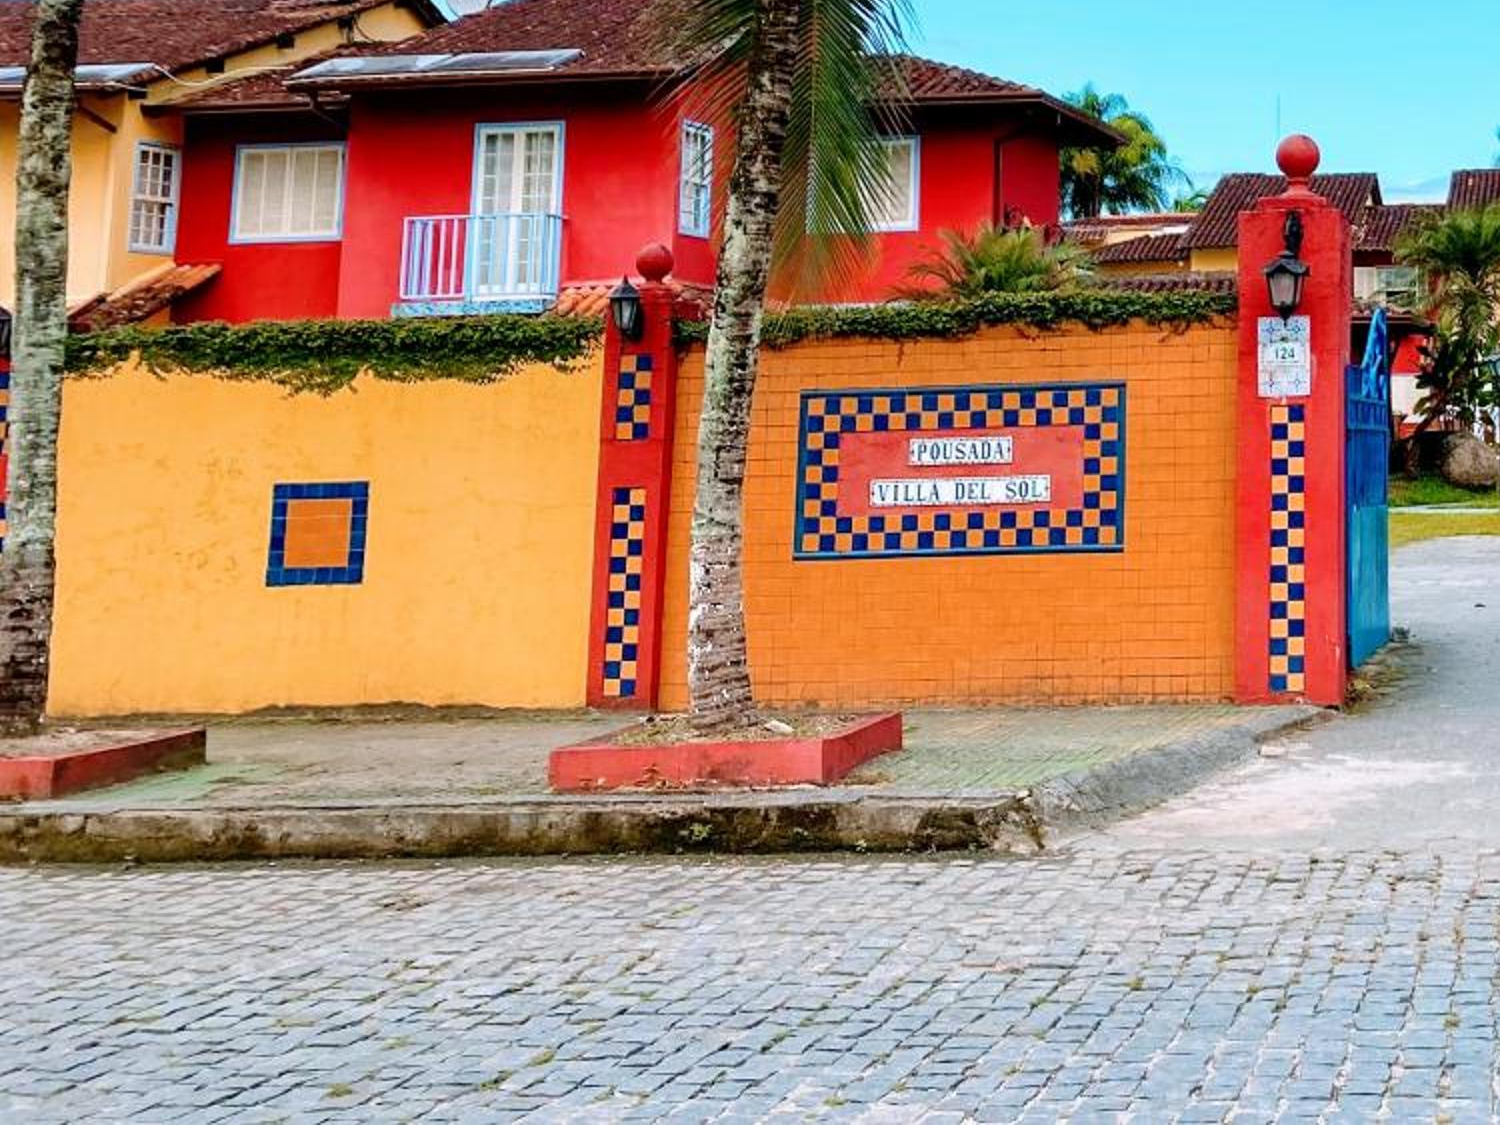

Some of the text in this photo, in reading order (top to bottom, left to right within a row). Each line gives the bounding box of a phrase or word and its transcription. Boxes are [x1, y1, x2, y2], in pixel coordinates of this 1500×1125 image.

[1275, 346, 1295, 360] 124
[917, 441, 1004, 461] POUSADA
[877, 480, 1042, 502] VILLA DEL SOL
